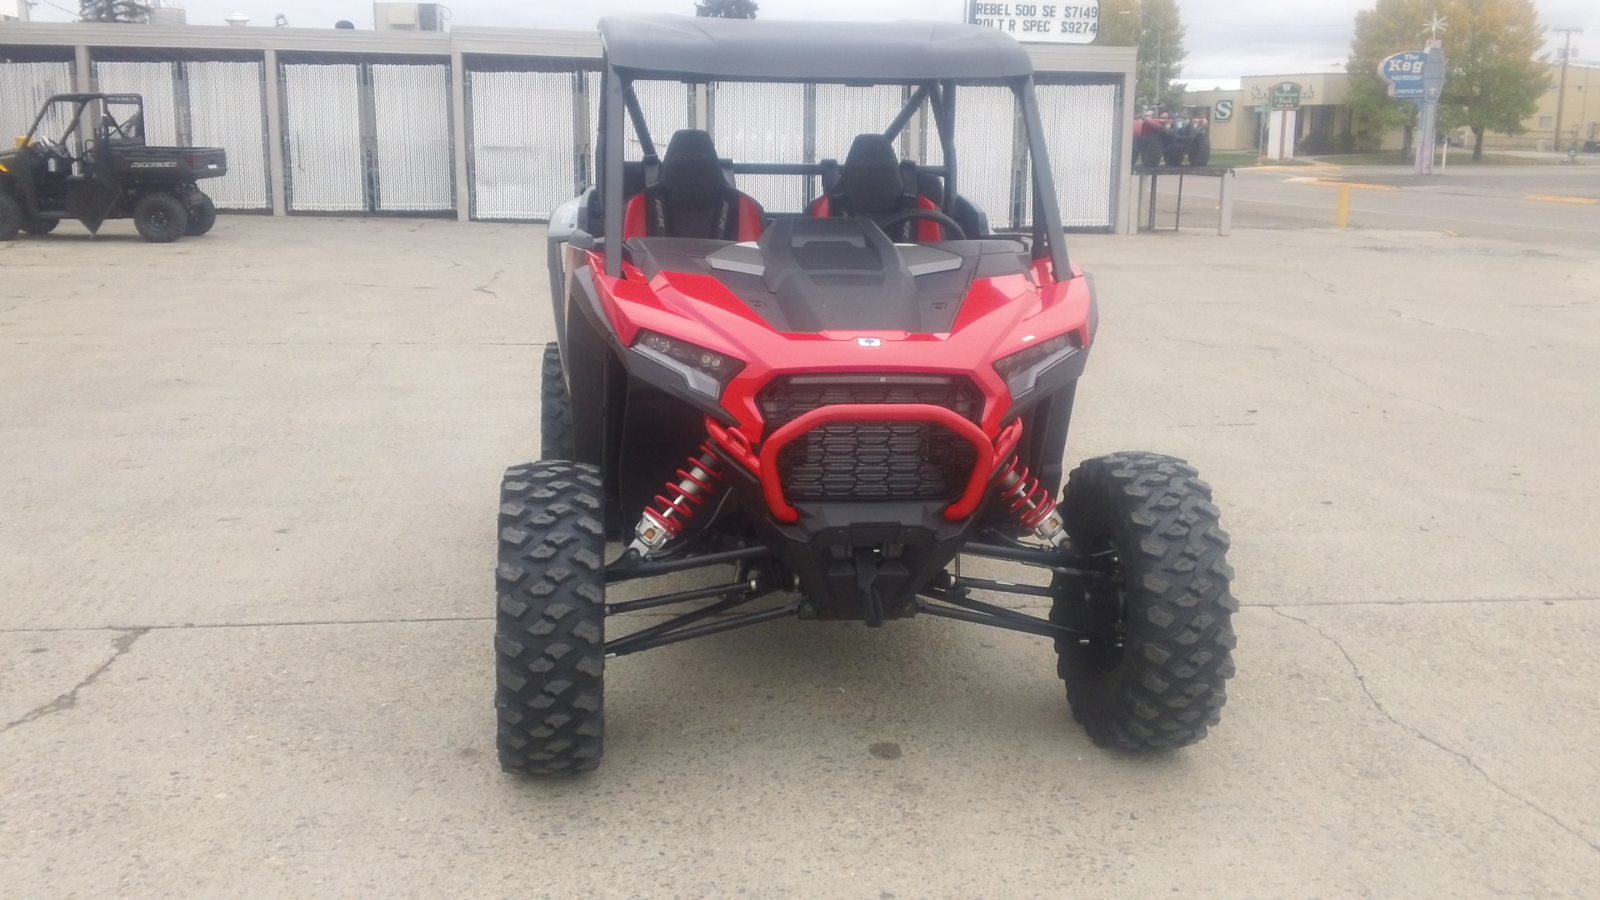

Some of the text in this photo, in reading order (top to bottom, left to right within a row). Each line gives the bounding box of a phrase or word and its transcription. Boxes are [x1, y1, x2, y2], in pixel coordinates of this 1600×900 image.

[976, 3, 1011, 16] REBEL
[1015, 4, 1037, 17] 500
[1042, 5, 1056, 18] SE
[1008, 19, 1016, 31] R
[1022, 19, 1051, 33] SPEC
[1388, 59, 1424, 73] Keg
[1215, 100, 1232, 121] S
